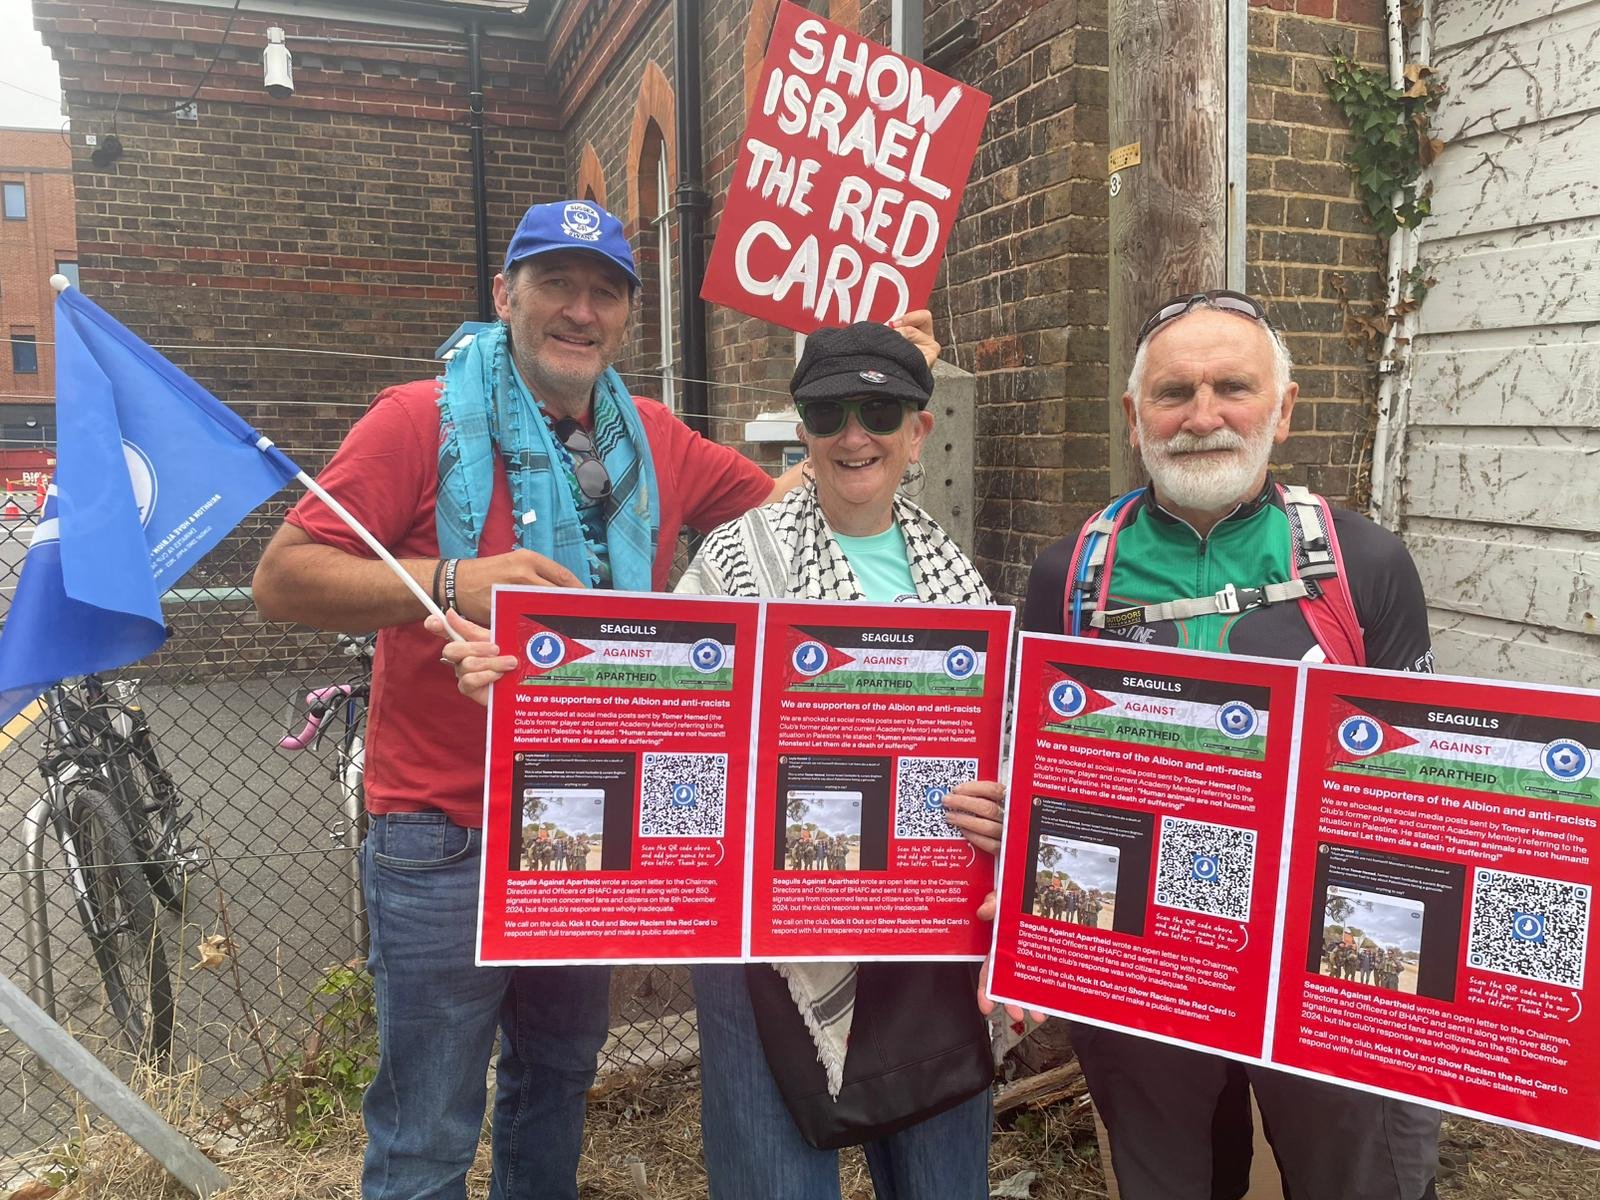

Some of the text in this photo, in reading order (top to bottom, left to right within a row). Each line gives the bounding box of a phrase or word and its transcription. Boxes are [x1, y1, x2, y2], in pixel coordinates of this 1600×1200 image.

[789, 19, 963, 134] SHOW
[764, 67, 951, 200] ISRAEL
[746, 138, 940, 267] THE RED
[735, 220, 910, 327] CARD
[445, 559, 458, 580] APART
[445, 580, 455, 588] TO
[446, 588, 455, 598] NO
[1106, 610, 1142, 623] OUTDOORS
[600, 624, 657, 635] SEAGULLS
[862, 633, 914, 643] SEAGULLS
[603, 648, 652, 658] AGAINST
[863, 656, 908, 665] AGAINST
[596, 672, 657, 682] APARTHEID
[856, 678, 913, 688] APARTHEID
[1122, 677, 1182, 693] SEAGULLS
[515, 693, 532, 703] We
[550, 696, 602, 705] supporters
[602, 696, 613, 705] of
[614, 696, 630, 705] the
[631, 697, 661, 706] Albion
[662, 698, 680, 706] and
[680, 699, 731, 708] anti-racists
[781, 700, 982, 714] We are supporters of the Albion and anti-racists
[1124, 702, 1176, 716] AGAINST
[1427, 711, 1500, 730] SEAGULLS
[1116, 724, 1180, 742] APARTHEID
[1429, 739, 1492, 756] AGAINST
[1036, 738, 1262, 780] We are supporters of the Albion and anti-racists
[1419, 765, 1498, 786] APARTHEID
[1323, 779, 1597, 828] We are supporters of the Albion and anti-racists
[1321, 797, 1335, 805] We
[1349, 802, 1383, 813] shocked
[1393, 808, 1417, 817] social
[1417, 812, 1444, 822] media
[1445, 816, 1468, 825] posts
[1469, 819, 1488, 828] sent
[1488, 821, 1500, 831] by
[1501, 823, 1531, 834] Tomer
[1531, 827, 1566, 840] Hemed
[1319, 817, 1353, 827] situation
[1400, 828, 1413, 837] He
[1413, 831, 1440, 841] stated
[1444, 835, 1480, 847] "Human
[1480, 842, 1516, 853] animals
[1516, 847, 1532, 856] are
[1533, 850, 1549, 859] not
[1320, 806, 1587, 854] Club's former player and current Academy Mentor) referring to the
[1360, 832, 1374, 841] Let
[1375, 834, 1397, 844] them
[1397, 838, 1412, 847] die
[1419, 841, 1445, 852] death
[1446, 846, 1456, 854] of
[507, 878, 538, 887] Seagulls
[537, 878, 565, 887] Against
[565, 878, 601, 887] Apartheid
[1015, 962, 1026, 970] We
[1026, 965, 1039, 973] call
[1048, 969, 1059, 977] the
[1076, 975, 1093, 985] Kick
[1099, 980, 1113, 990] Out
[1113, 984, 1128, 993] and
[1128, 986, 1149, 997] Show
[1149, 991, 1177, 1004] Racism
[1178, 998, 1191, 1007] the
[1191, 1000, 1208, 1011] Red
[1208, 1005, 1228, 1016] Card
[1228, 1010, 1236, 1018] to
[1469, 976, 1563, 1003] Scan the QR code above
[1468, 986, 1570, 1013] and add your name to our
[1468, 995, 1485, 1004] open
[1517, 1003, 1541, 1016] Thank
